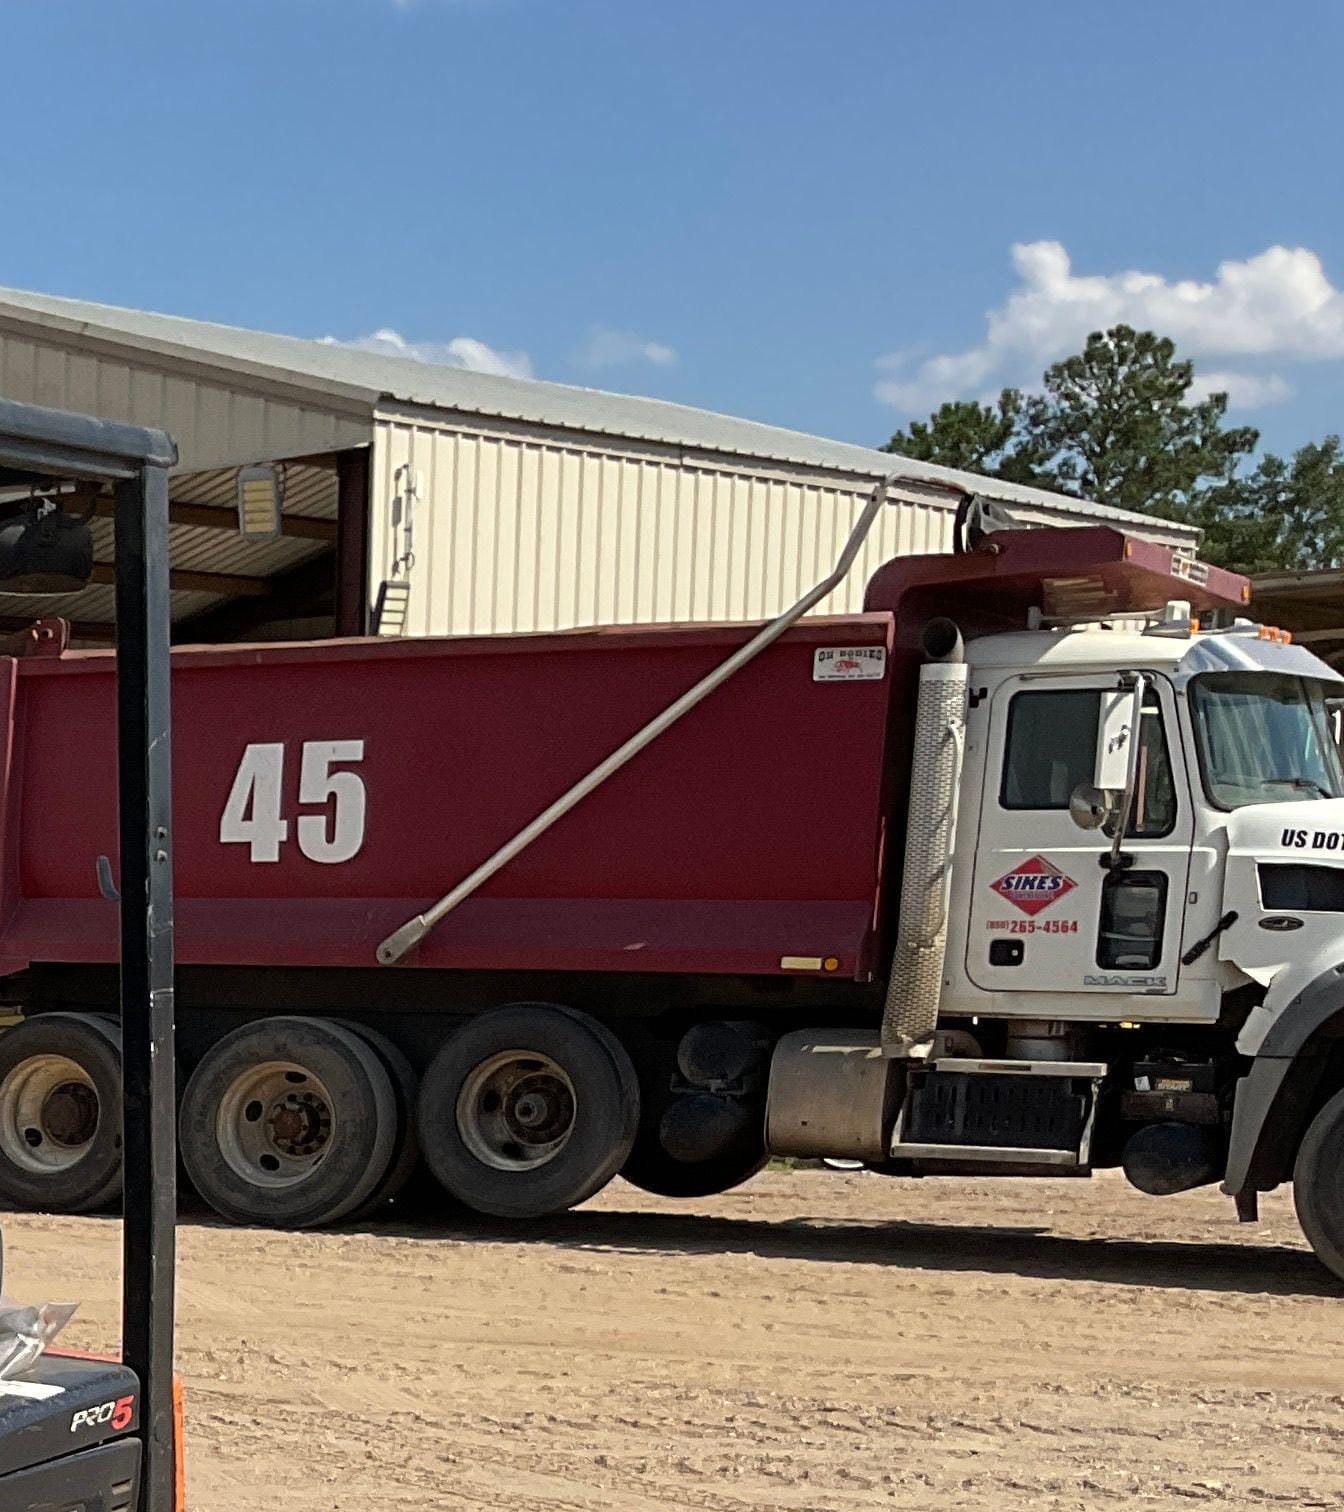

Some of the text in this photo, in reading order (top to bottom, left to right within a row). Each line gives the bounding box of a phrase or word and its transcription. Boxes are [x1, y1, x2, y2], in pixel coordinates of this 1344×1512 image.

[219, 739, 367, 864] 45
[1281, 828, 1344, 851] US DO
[1001, 875, 1063, 890] SIKES
[1010, 920, 1079, 933] 265-4564
[1083, 975, 1167, 987] MACK
